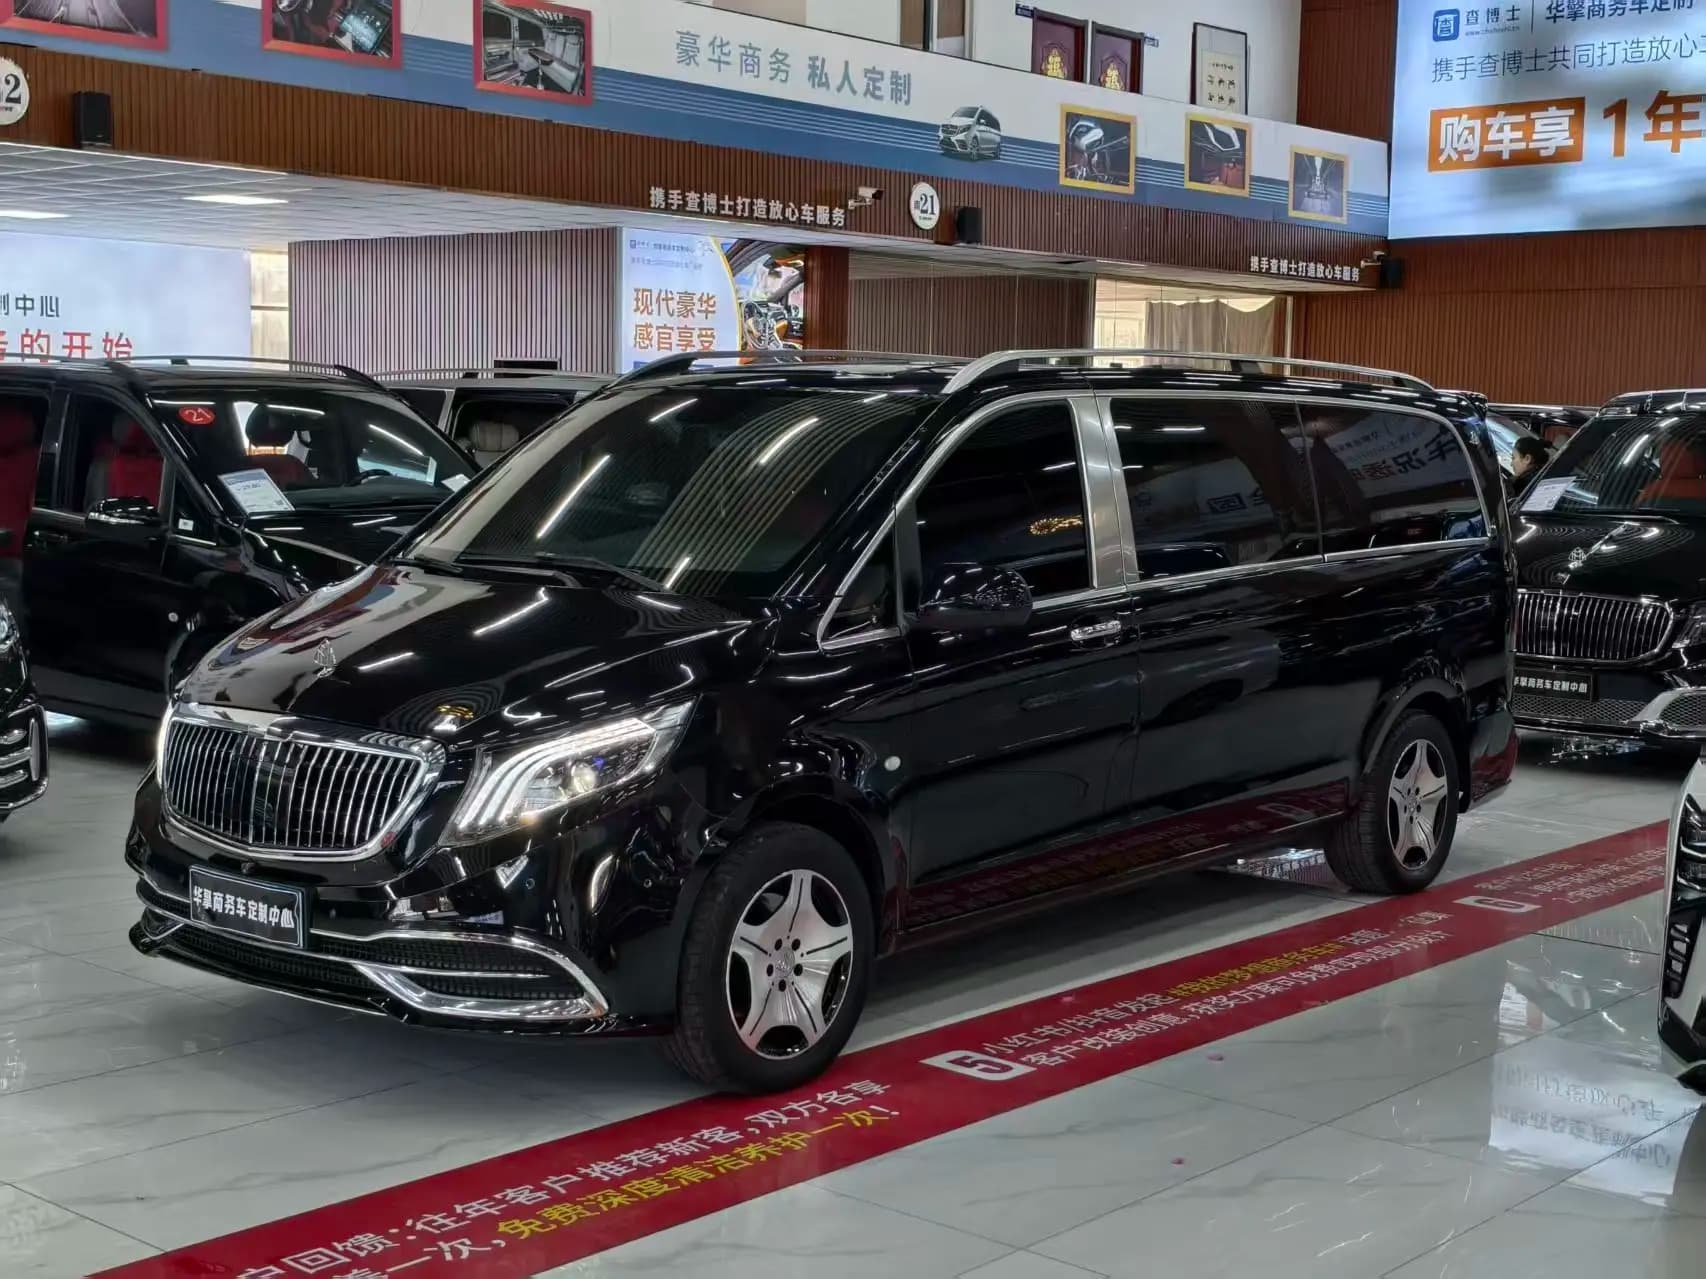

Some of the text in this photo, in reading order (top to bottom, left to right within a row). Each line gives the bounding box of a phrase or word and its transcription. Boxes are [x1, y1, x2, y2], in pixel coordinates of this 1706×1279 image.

[1465, 5, 1520, 25] 查博士
[676, 29, 912, 106] 豪华商务 私人定制
[1438, 106, 1576, 164] 购车享
[649, 185, 846, 228] 携手查博士打造放心车服务
[920, 193, 936, 215] 21
[633, 287, 717, 320] 现代豪华
[633, 322, 716, 352] 感官享受
[947, 1055, 1014, 1074] 5
